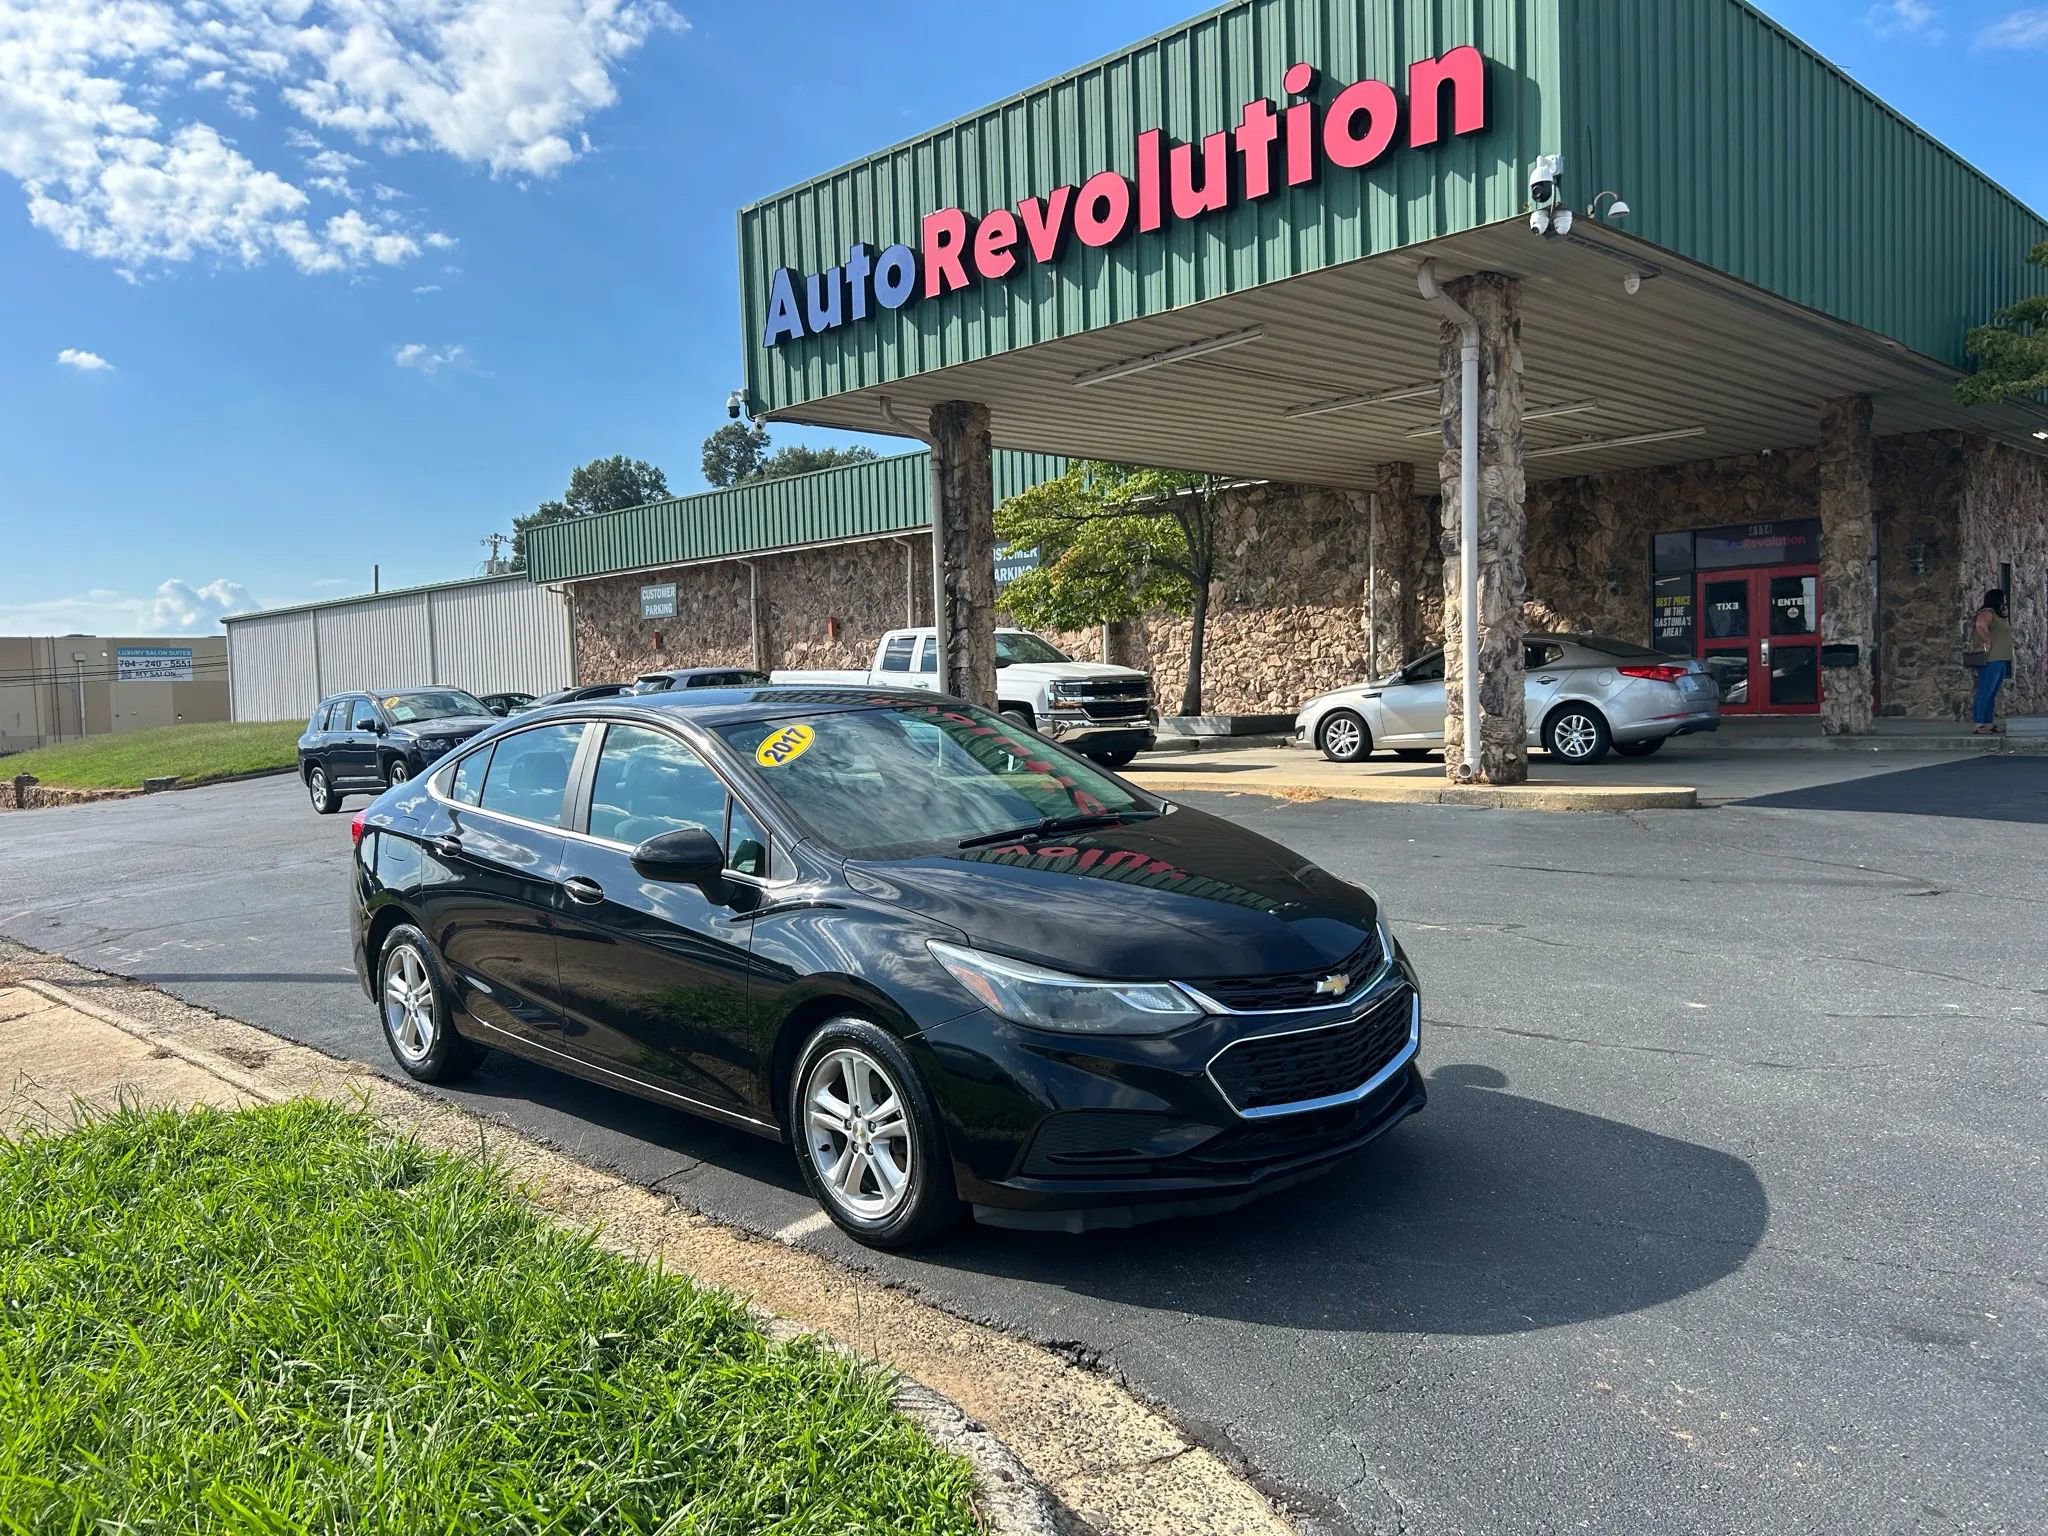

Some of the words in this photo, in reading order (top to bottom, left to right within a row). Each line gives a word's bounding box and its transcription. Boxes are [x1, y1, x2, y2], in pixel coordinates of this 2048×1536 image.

[994, 565, 1032, 581] ARKIN
[642, 586, 675, 600] CUSTOMER
[1656, 597, 1672, 607] BEST
[1673, 595, 1691, 606] PRICE
[645, 603, 673, 616] PARKING
[1664, 607, 1672, 617] IN
[1673, 606, 1685, 617] THE
[1662, 626, 1683, 638] AREA!
[764, 727, 807, 762] 2017
